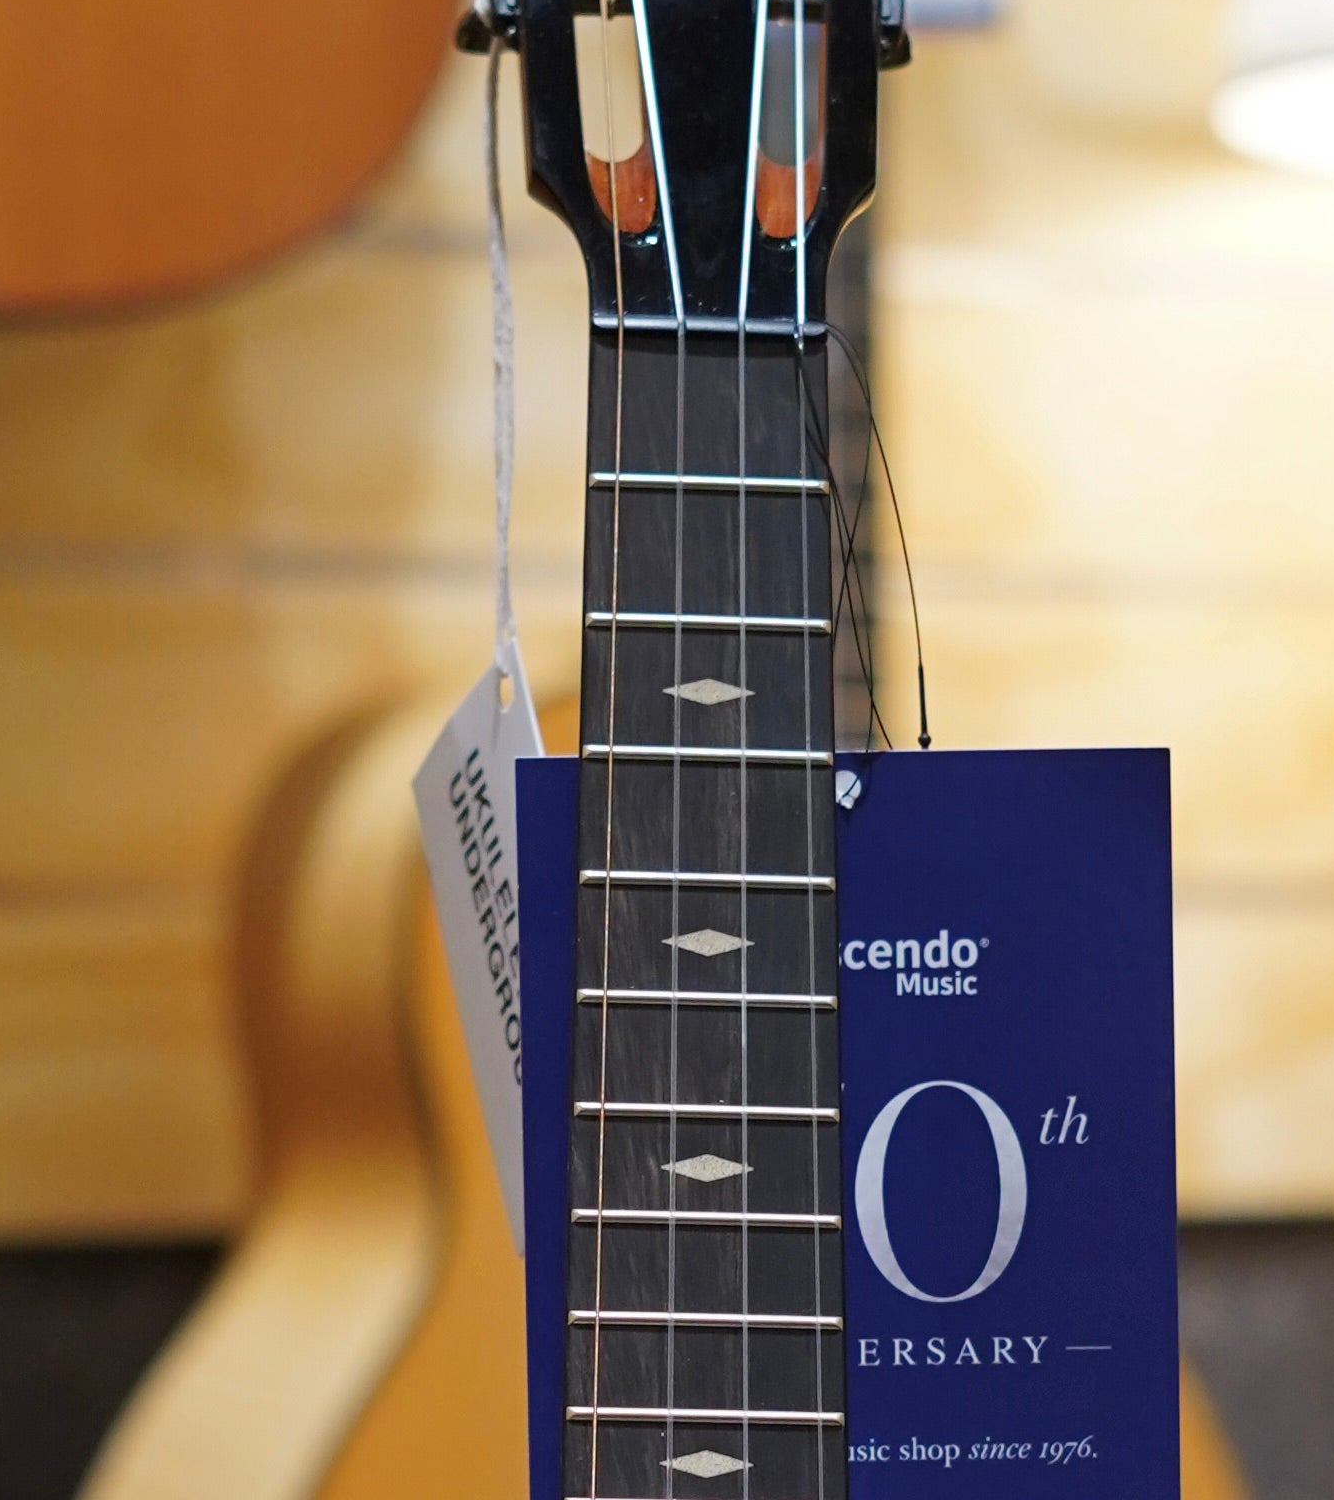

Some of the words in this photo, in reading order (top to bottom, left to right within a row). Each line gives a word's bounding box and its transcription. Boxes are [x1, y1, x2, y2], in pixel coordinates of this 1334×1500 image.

[466, 748, 520, 980] UKULEL
[839, 929, 979, 971] cendo
[896, 970, 978, 997] Music
[857, 1335, 1049, 1367] ERSARY
[898, 1436, 961, 1469] shop
[967, 1436, 1032, 1461] since
[1039, 1435, 1098, 1466] 1976.
